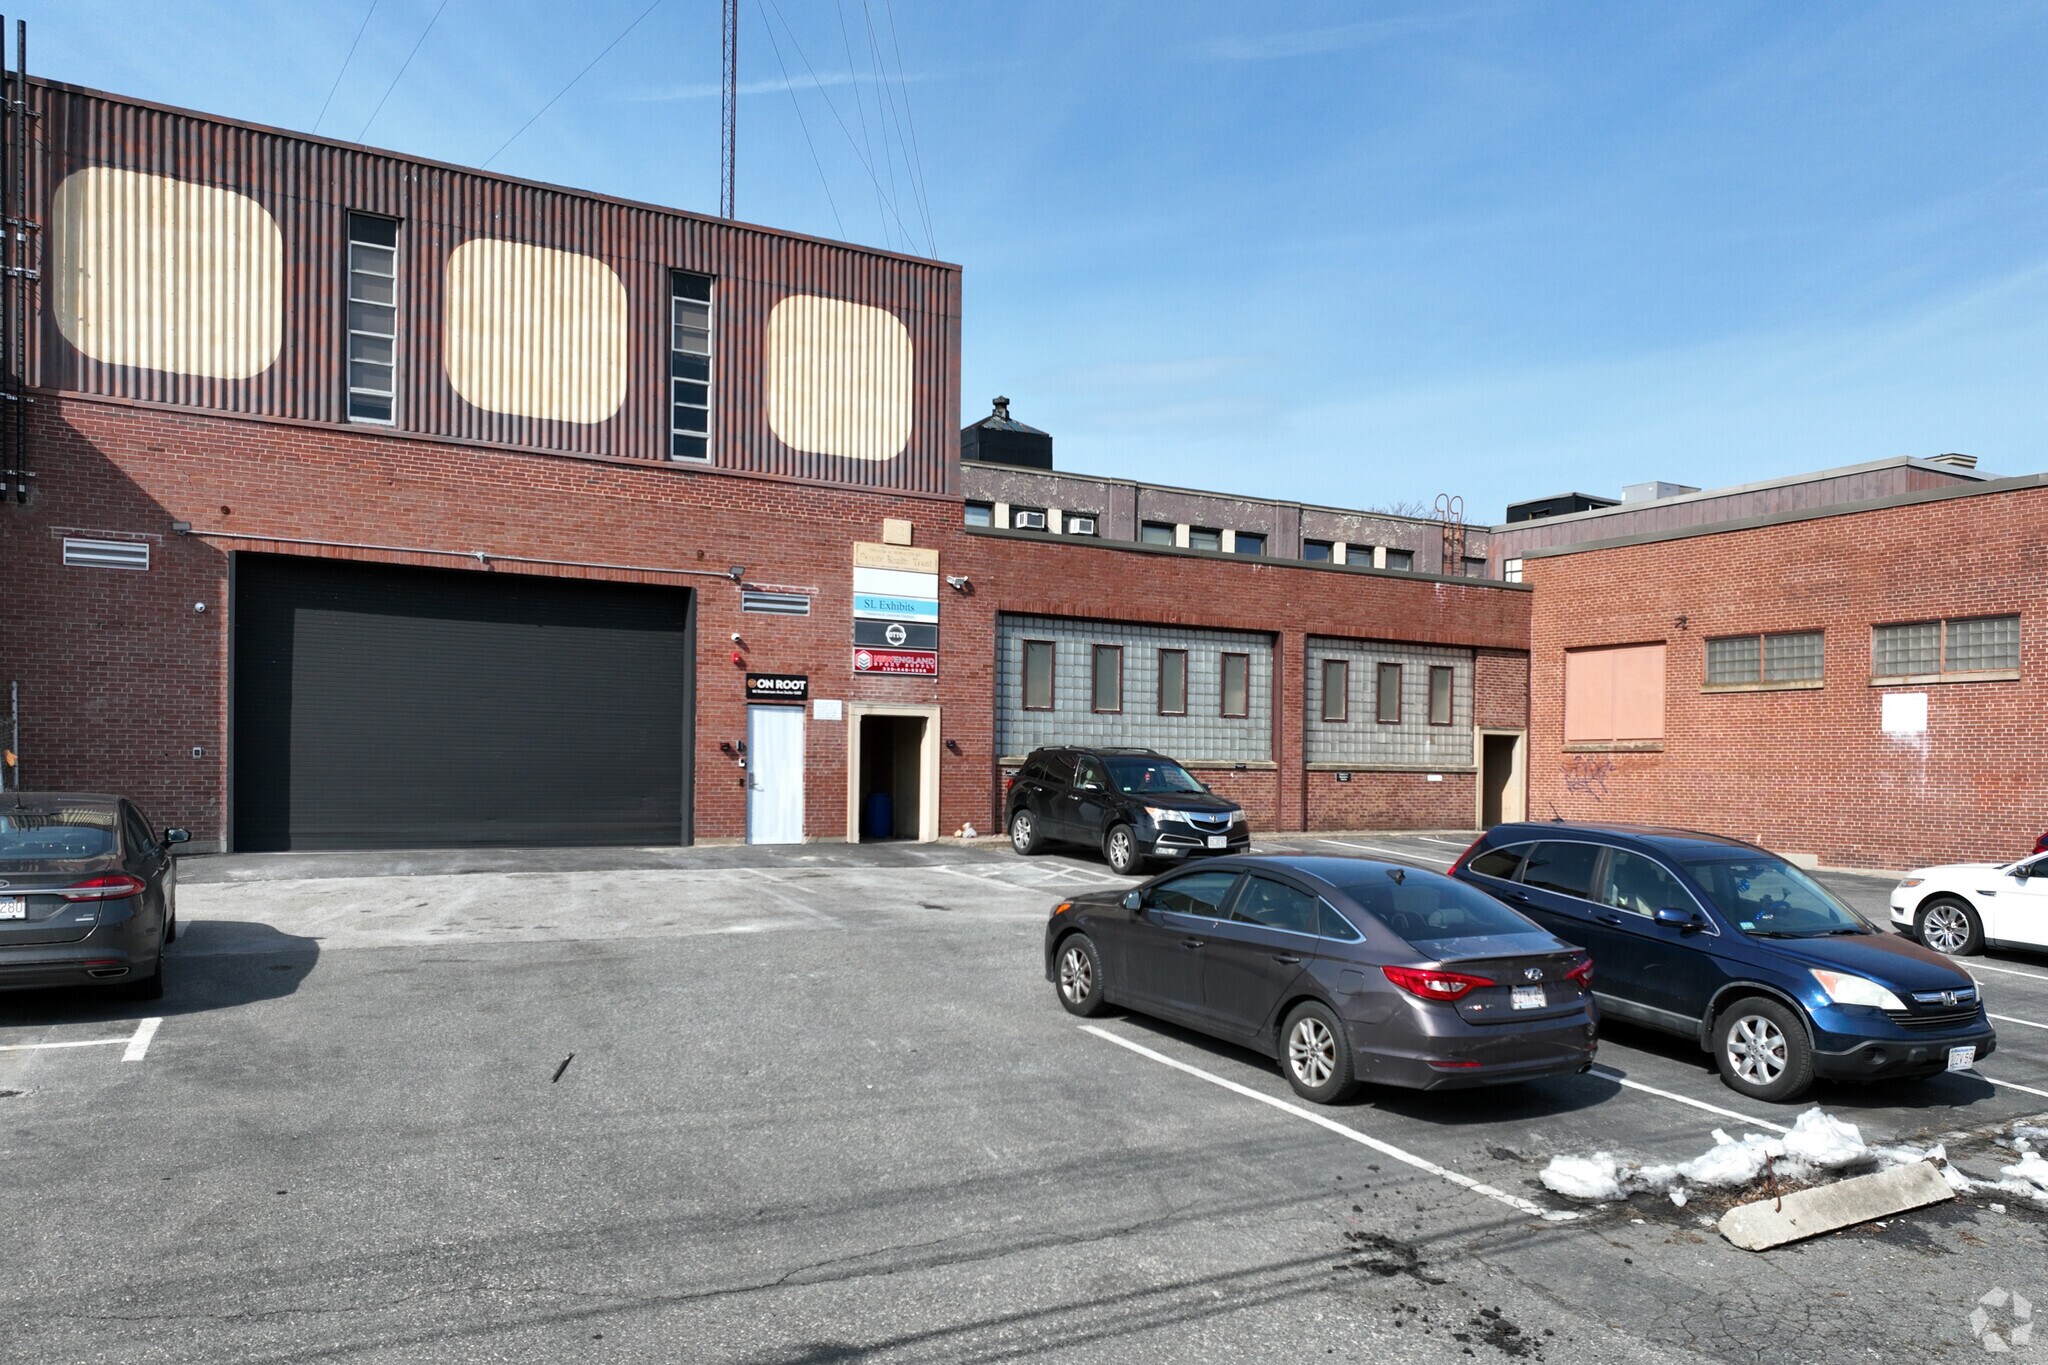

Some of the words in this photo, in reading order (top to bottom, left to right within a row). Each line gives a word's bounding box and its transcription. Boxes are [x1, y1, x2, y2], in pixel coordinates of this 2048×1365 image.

[864, 599, 876, 609] SL
[879, 600, 915, 612] Exhibits
[756, 678, 774, 689] ON
[775, 679, 807, 690] ROOT
[0, 901, 23, 913] 280
